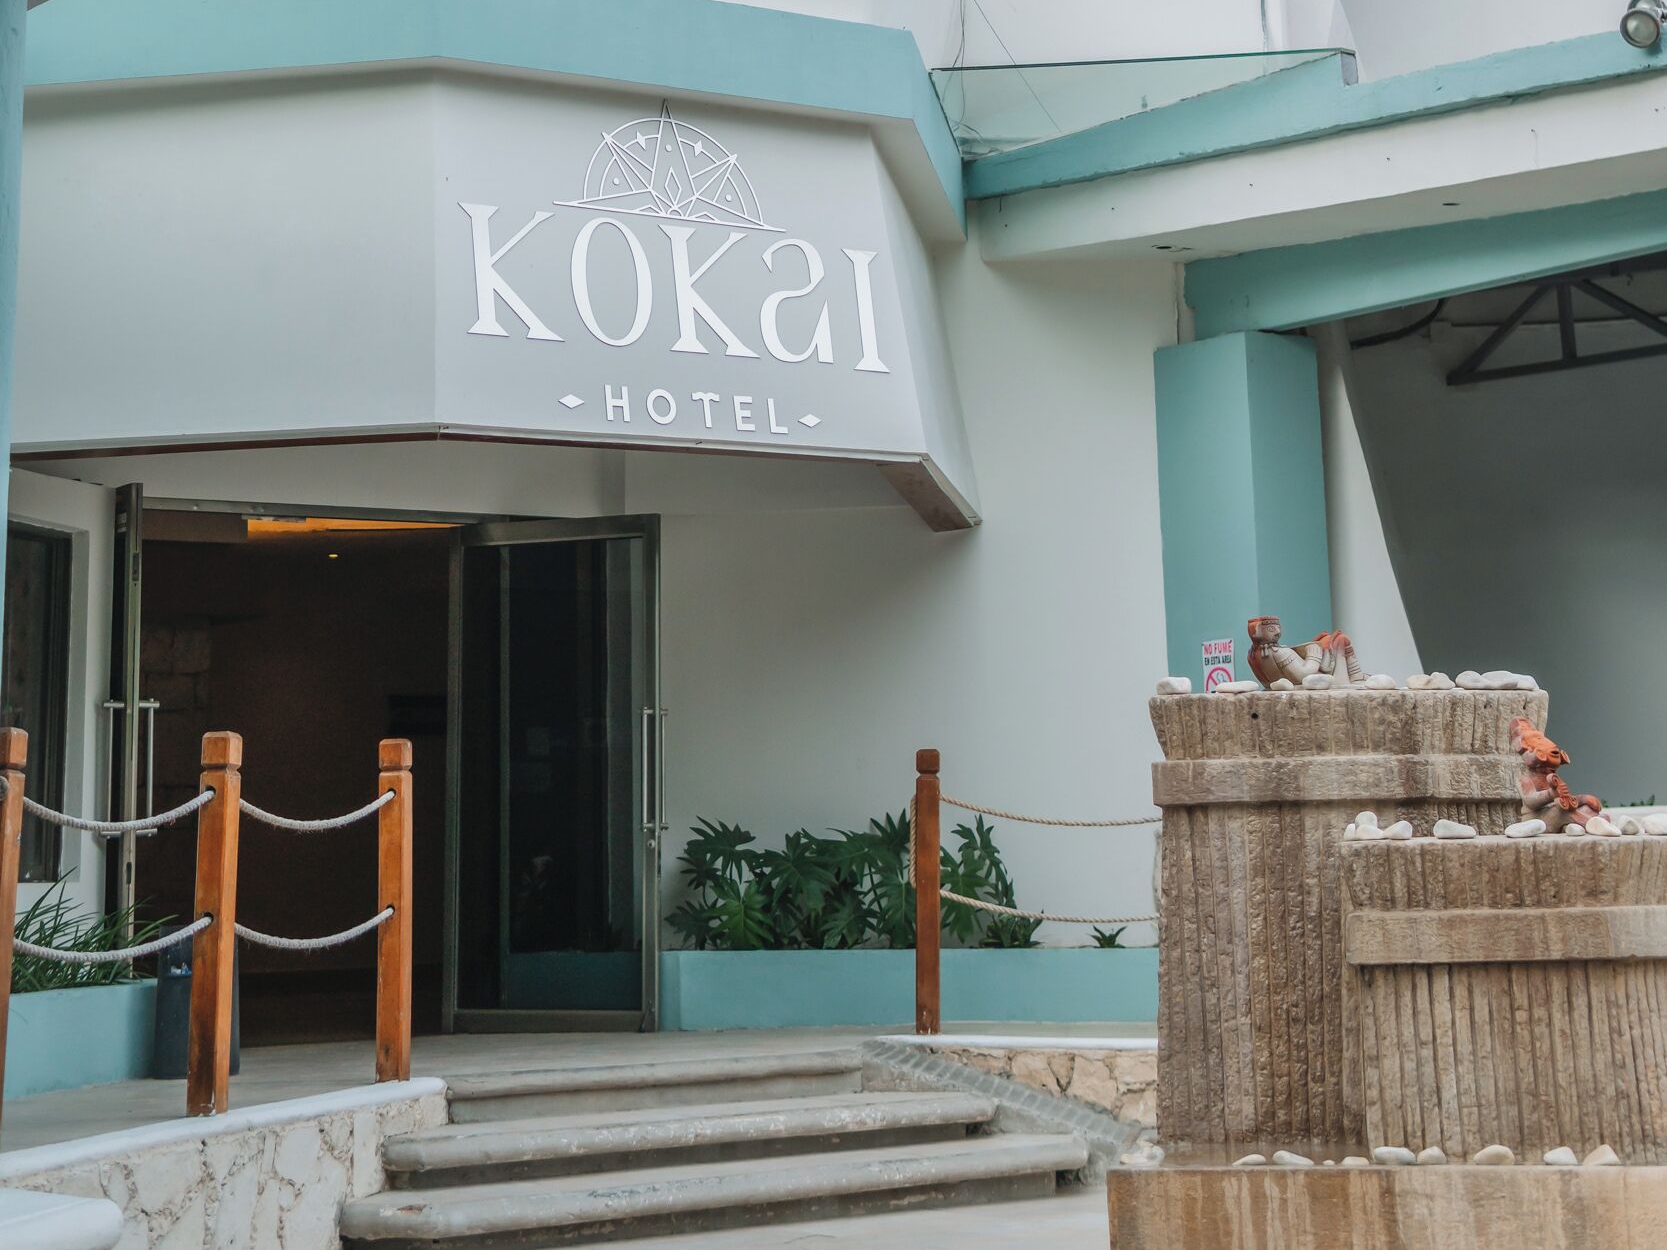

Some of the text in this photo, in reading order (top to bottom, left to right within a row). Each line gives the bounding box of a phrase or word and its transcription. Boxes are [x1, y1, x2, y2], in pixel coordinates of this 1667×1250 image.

[604, 384, 788, 434] HOTEL
[1203, 643, 1213, 655] NO
[1204, 655, 1232, 666] EN ESTA AREA
